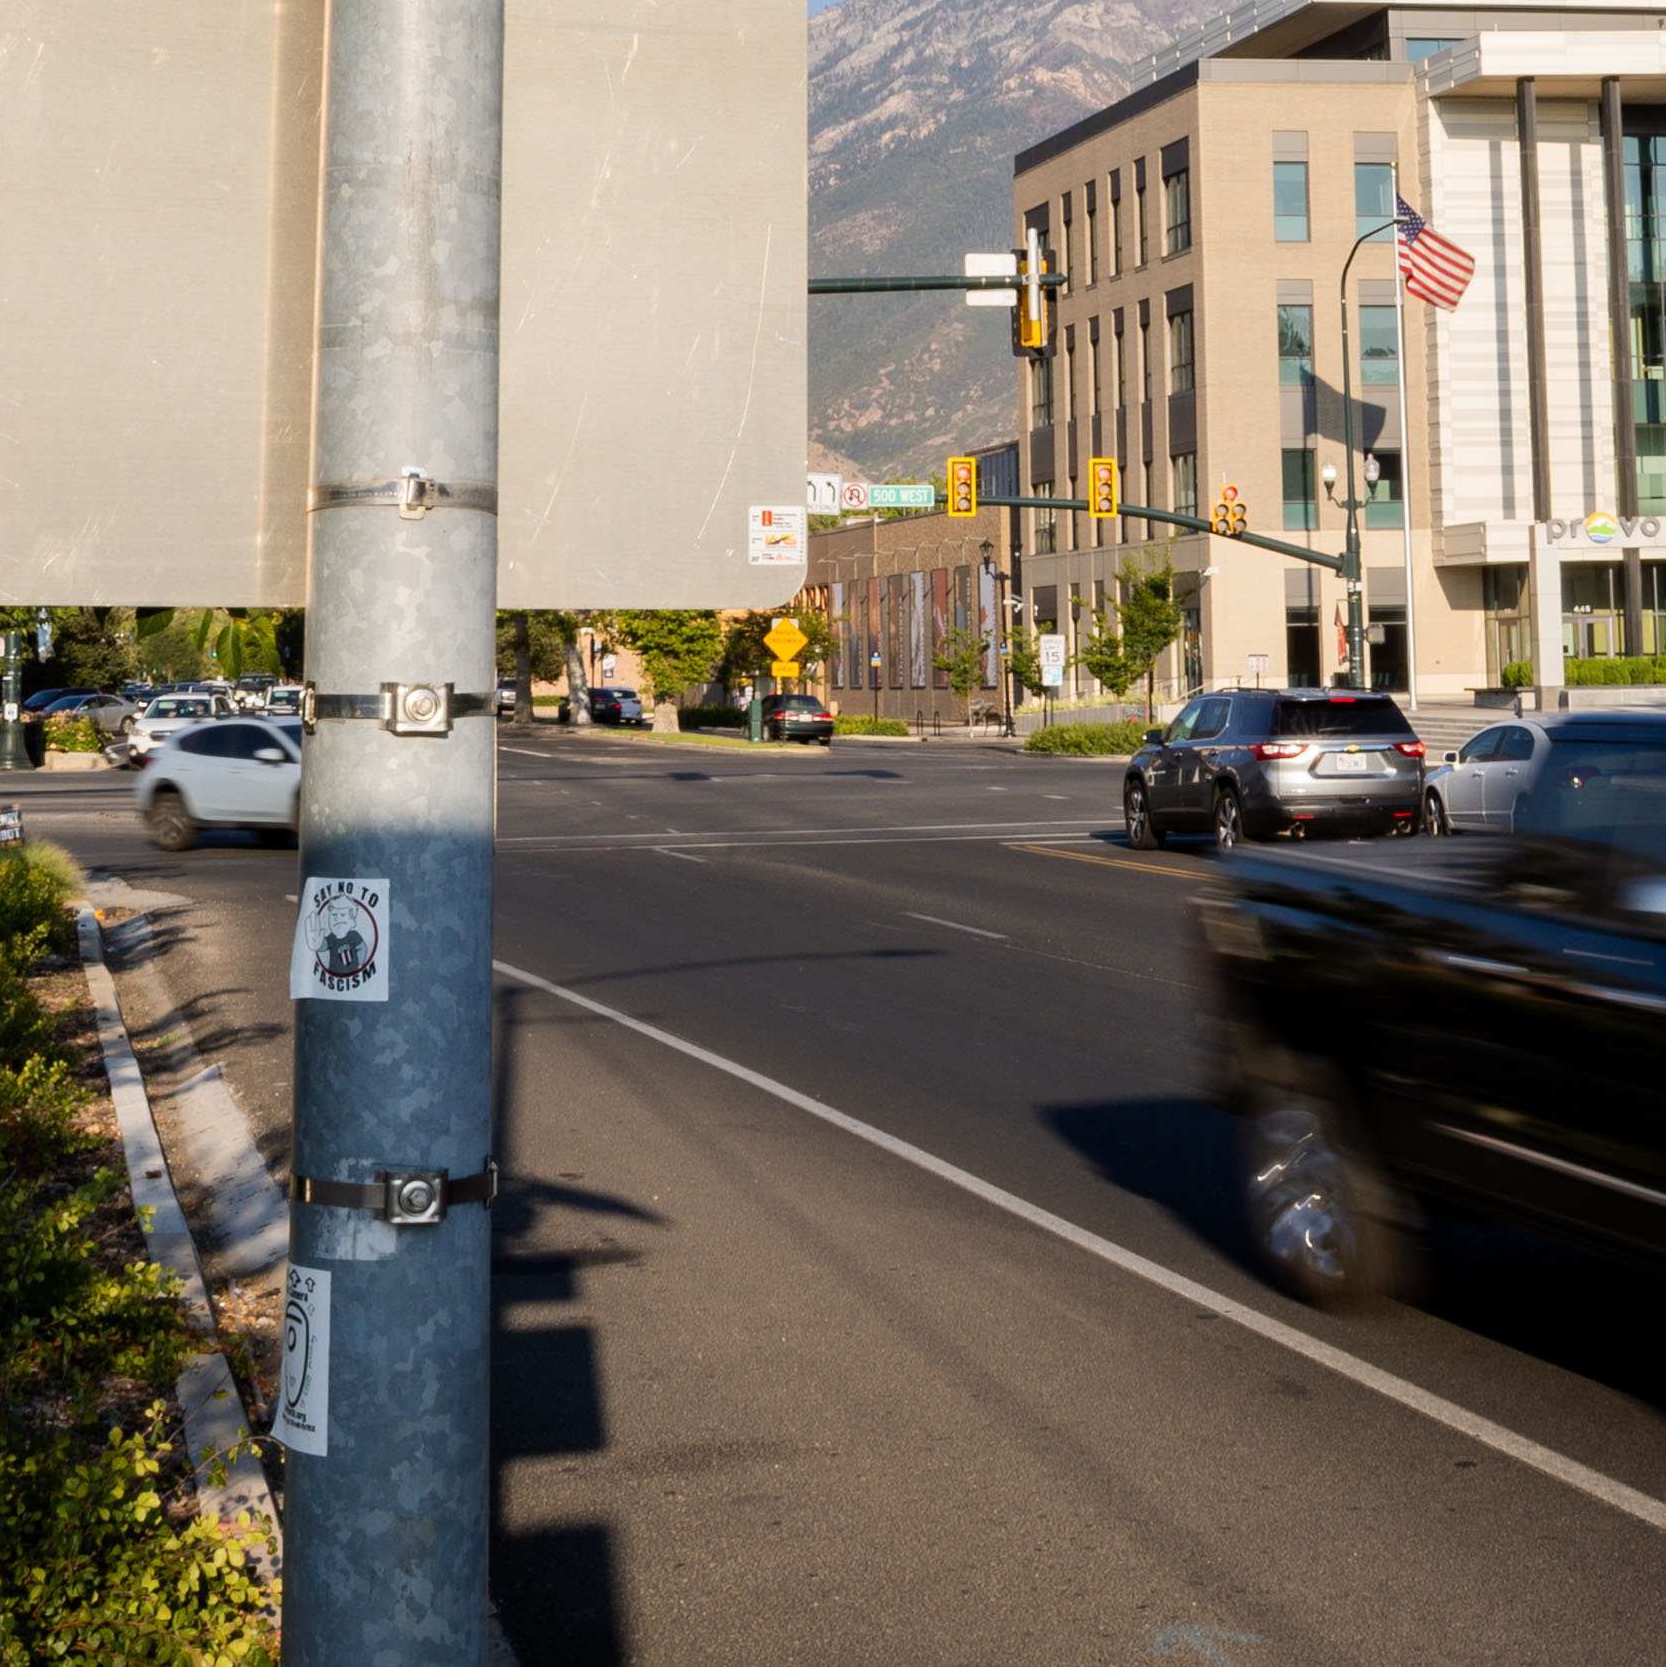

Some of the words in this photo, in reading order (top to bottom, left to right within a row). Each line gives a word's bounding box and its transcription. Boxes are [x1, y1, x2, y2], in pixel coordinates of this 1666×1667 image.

[873, 489, 896, 503] 500
[899, 489, 928, 503] WEST
[1045, 651, 1060, 663] 15
[314, 884, 332, 908] SAY
[338, 881, 354, 895] NO
[361, 886, 379, 908] TO
[313, 960, 377, 992] FASCISM
